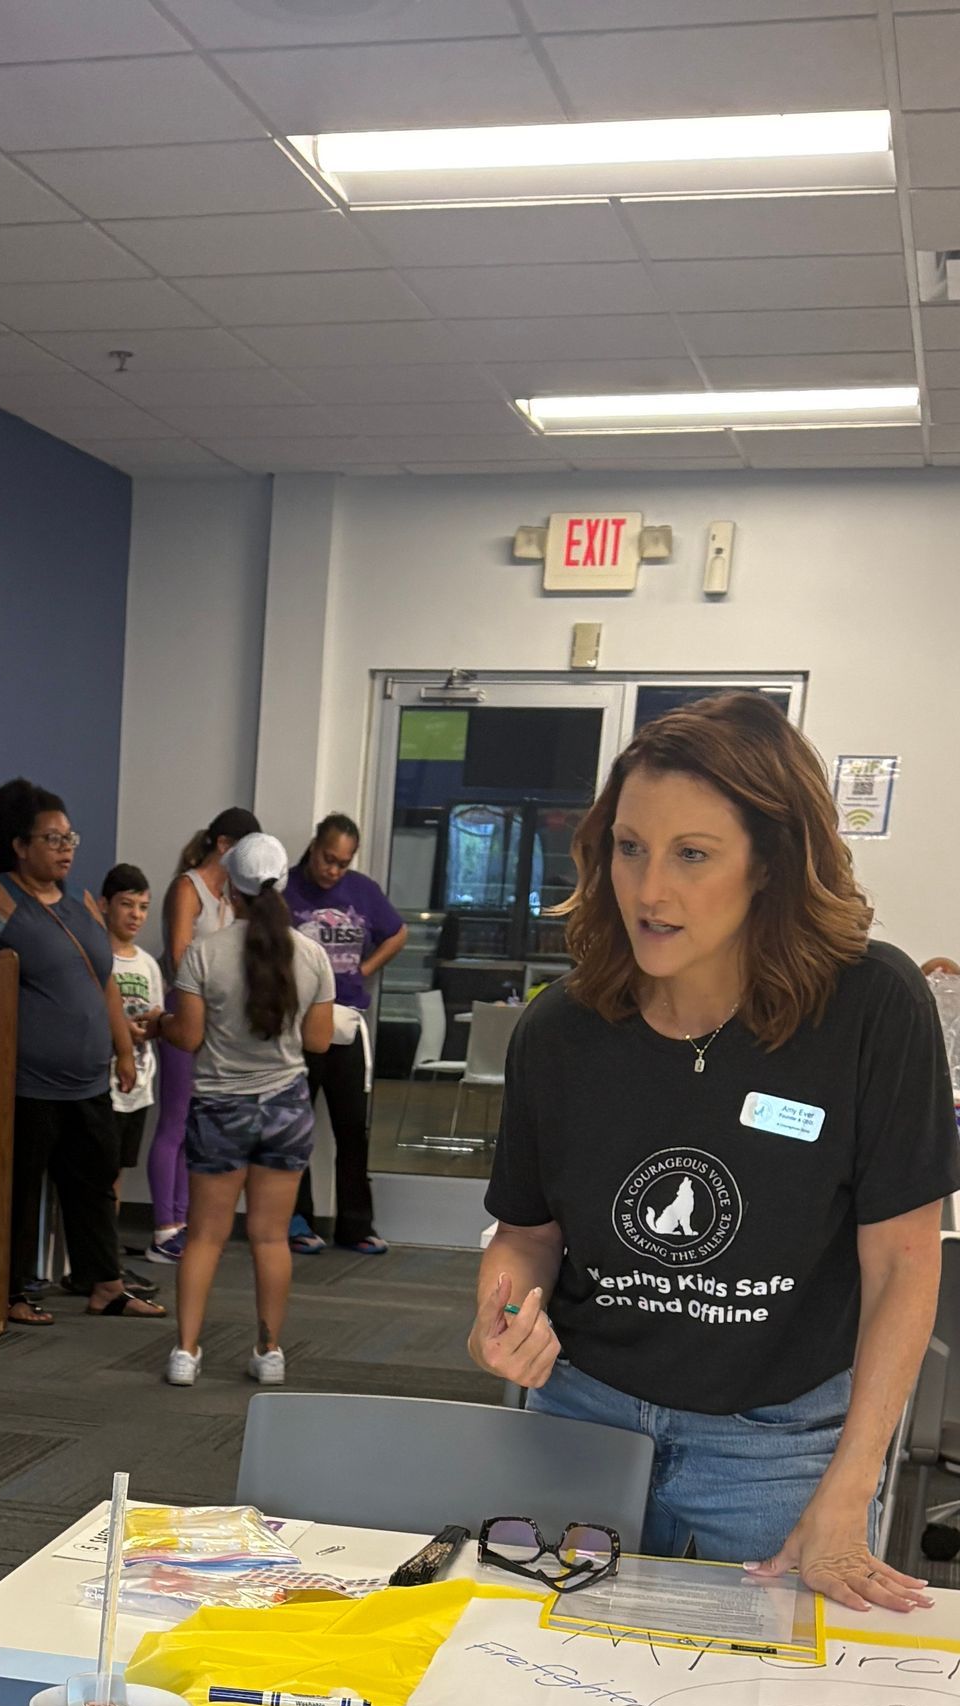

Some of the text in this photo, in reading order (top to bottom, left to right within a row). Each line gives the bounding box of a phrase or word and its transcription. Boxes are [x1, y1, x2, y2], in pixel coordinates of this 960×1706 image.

[563, 518, 627, 567] EXIT
[781, 1105, 797, 1116] Amy
[624, 1156, 731, 1207] A COURAGEOUS VOICE
[620, 1213, 733, 1262] BREAKING THE SILENCE
[677, 1274, 729, 1298] Kids
[735, 1275, 795, 1297] Safe
[638, 1296, 683, 1314] and
[688, 1300, 769, 1324] Offline
